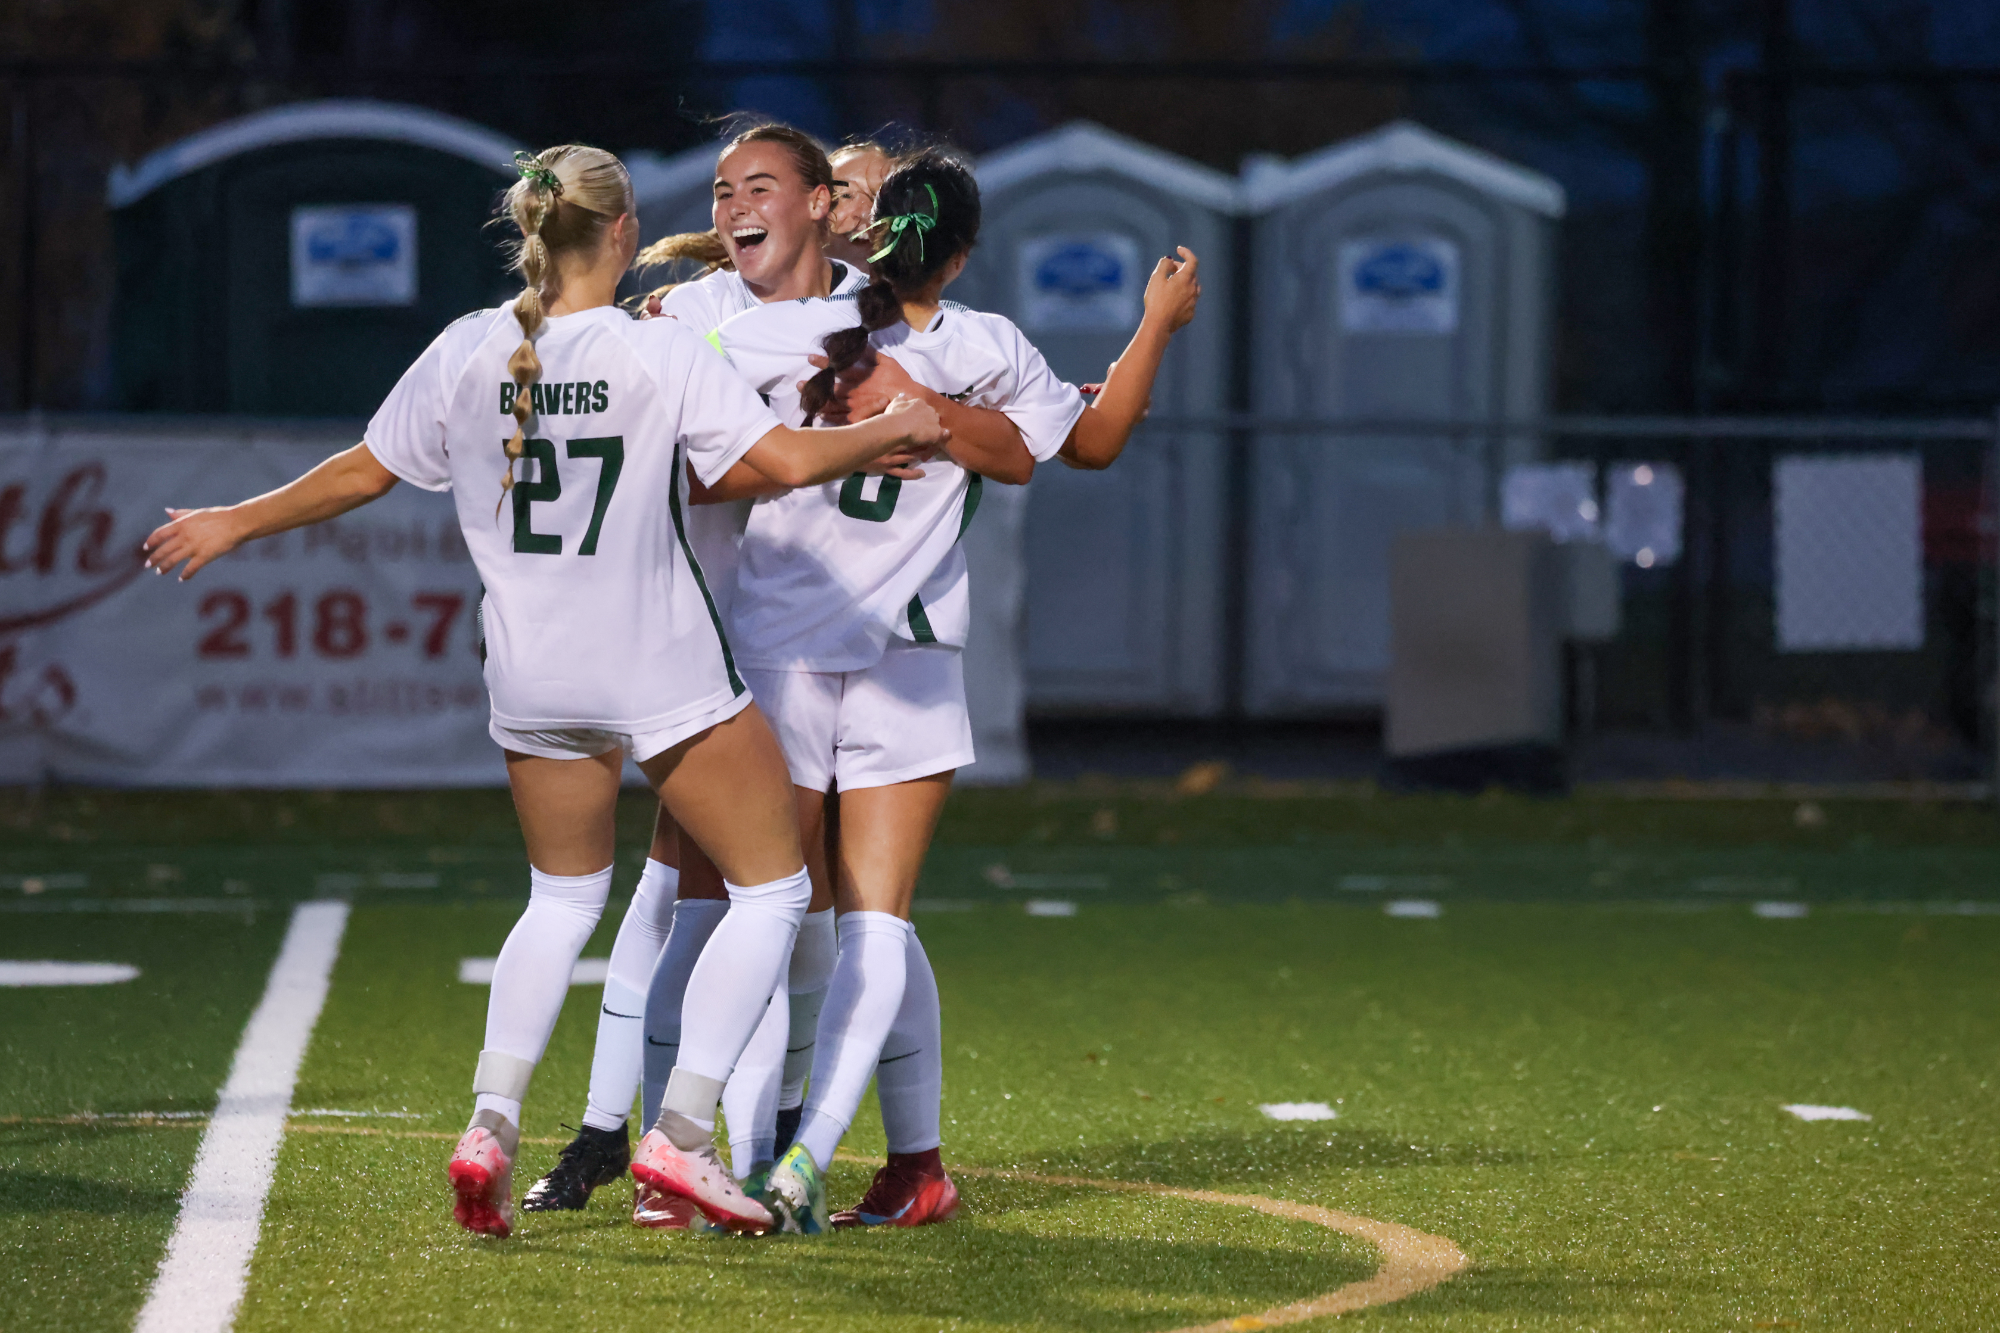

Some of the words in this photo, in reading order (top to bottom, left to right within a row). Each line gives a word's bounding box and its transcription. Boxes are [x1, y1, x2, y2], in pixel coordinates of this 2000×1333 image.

[500, 380, 608, 415] BAVERS
[502, 435, 625, 556] 27
[198, 588, 478, 659] 218-7
